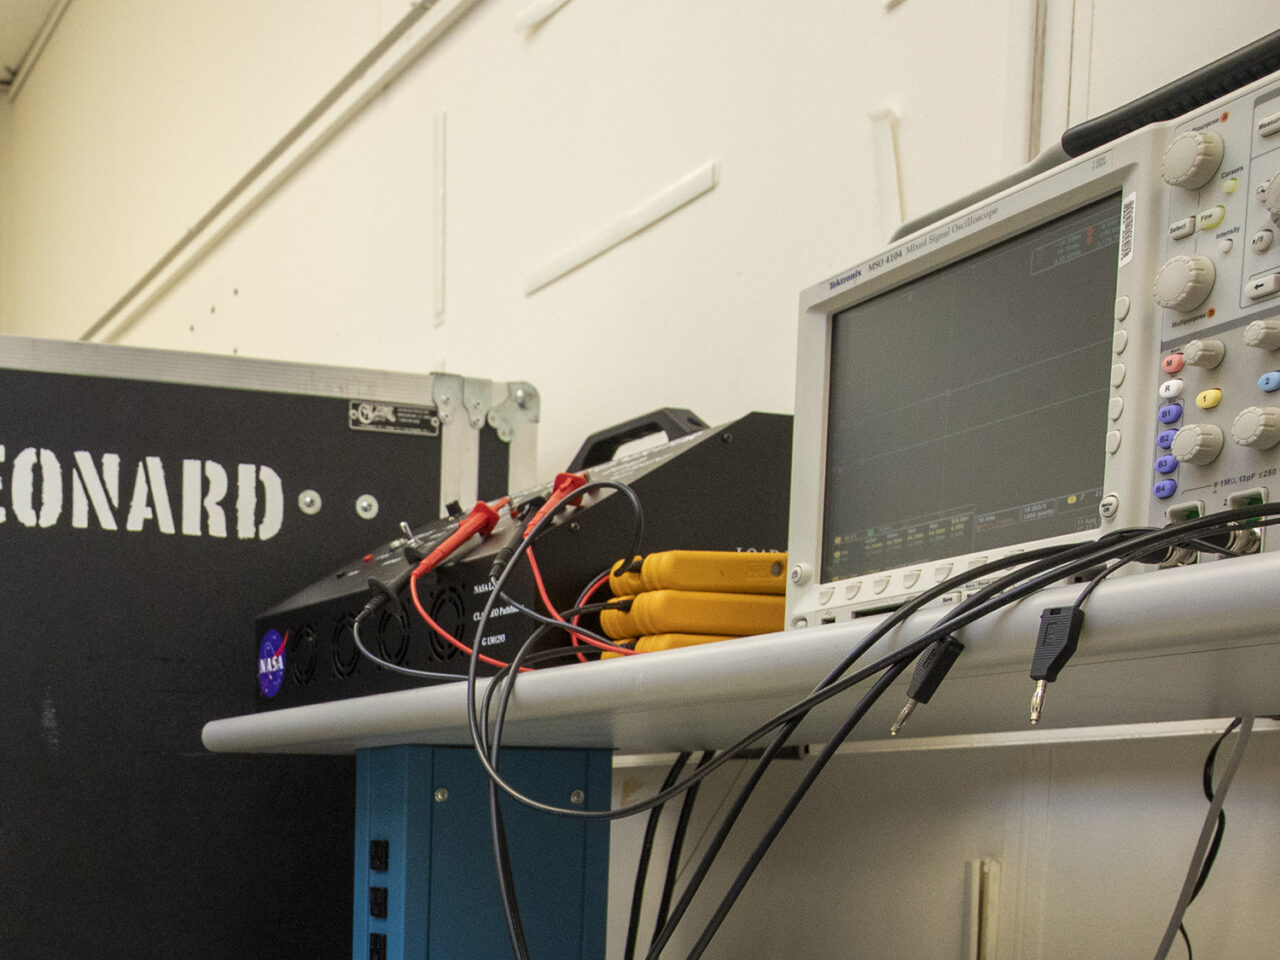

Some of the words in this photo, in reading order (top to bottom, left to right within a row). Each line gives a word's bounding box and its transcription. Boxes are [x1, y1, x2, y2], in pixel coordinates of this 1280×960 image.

[1221, 165, 1244, 179] Cursors
[1200, 213, 1213, 222] Fine
[1169, 223, 1187, 234] Select
[1215, 226, 1241, 239] Intensity
[829, 269, 862, 290] Tektronix
[885, 250, 903, 265] 4104
[905, 239, 928, 256] Mixed
[928, 226, 951, 246] Signal
[951, 207, 999, 234] Oscilloscope
[1166, 359, 1173, 367] M
[1264, 377, 1270, 386] 2
[1164, 385, 1171, 393] R
[1161, 410, 1171, 418] B1
[1159, 435, 1169, 443] B2
[1158, 460, 1168, 468] B3
[1155, 485, 1166, 493] B4
[259, 655, 284, 673] NASA
